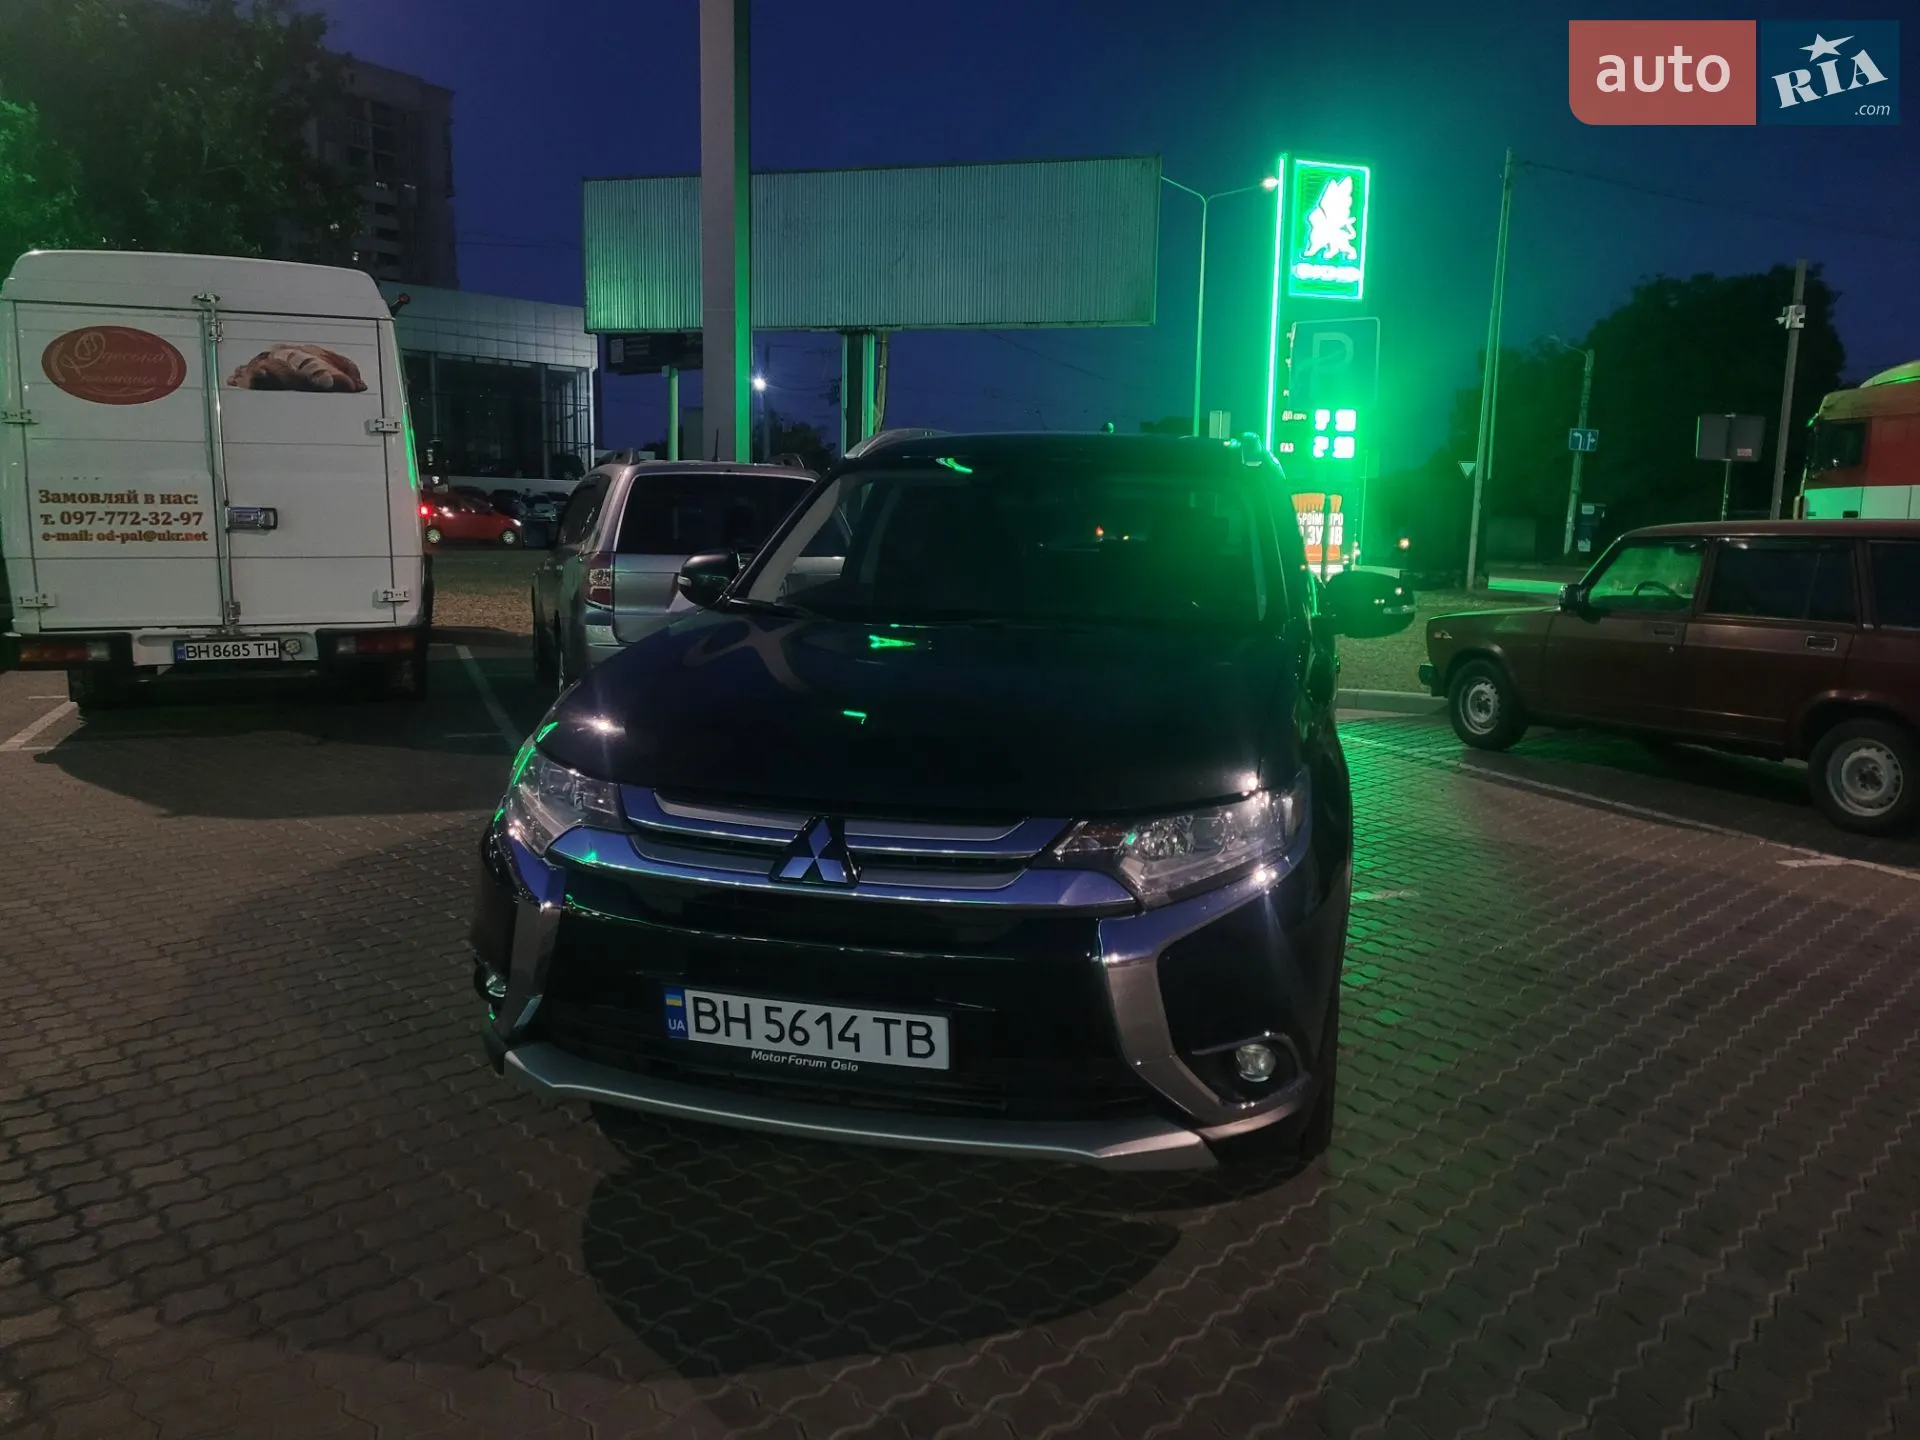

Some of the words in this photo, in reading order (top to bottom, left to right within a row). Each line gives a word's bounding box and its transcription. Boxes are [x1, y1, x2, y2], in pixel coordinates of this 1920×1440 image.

[38, 489, 139, 505] Замовляй
[144, 493, 155, 505] в
[160, 493, 199, 505] нас:
[60, 510, 204, 527] 097-772-32-97
[42, 530, 94, 542] e-mail:
[97, 530, 209, 545] od-pal@ukr.net
[213, 643, 250, 658] 8685
[668, 1018, 686, 1032] UA
[692, 996, 752, 1041] BH
[764, 1005, 861, 1053] 5614
[872, 1016, 936, 1060] TB
[831, 1059, 859, 1072] Oslo
